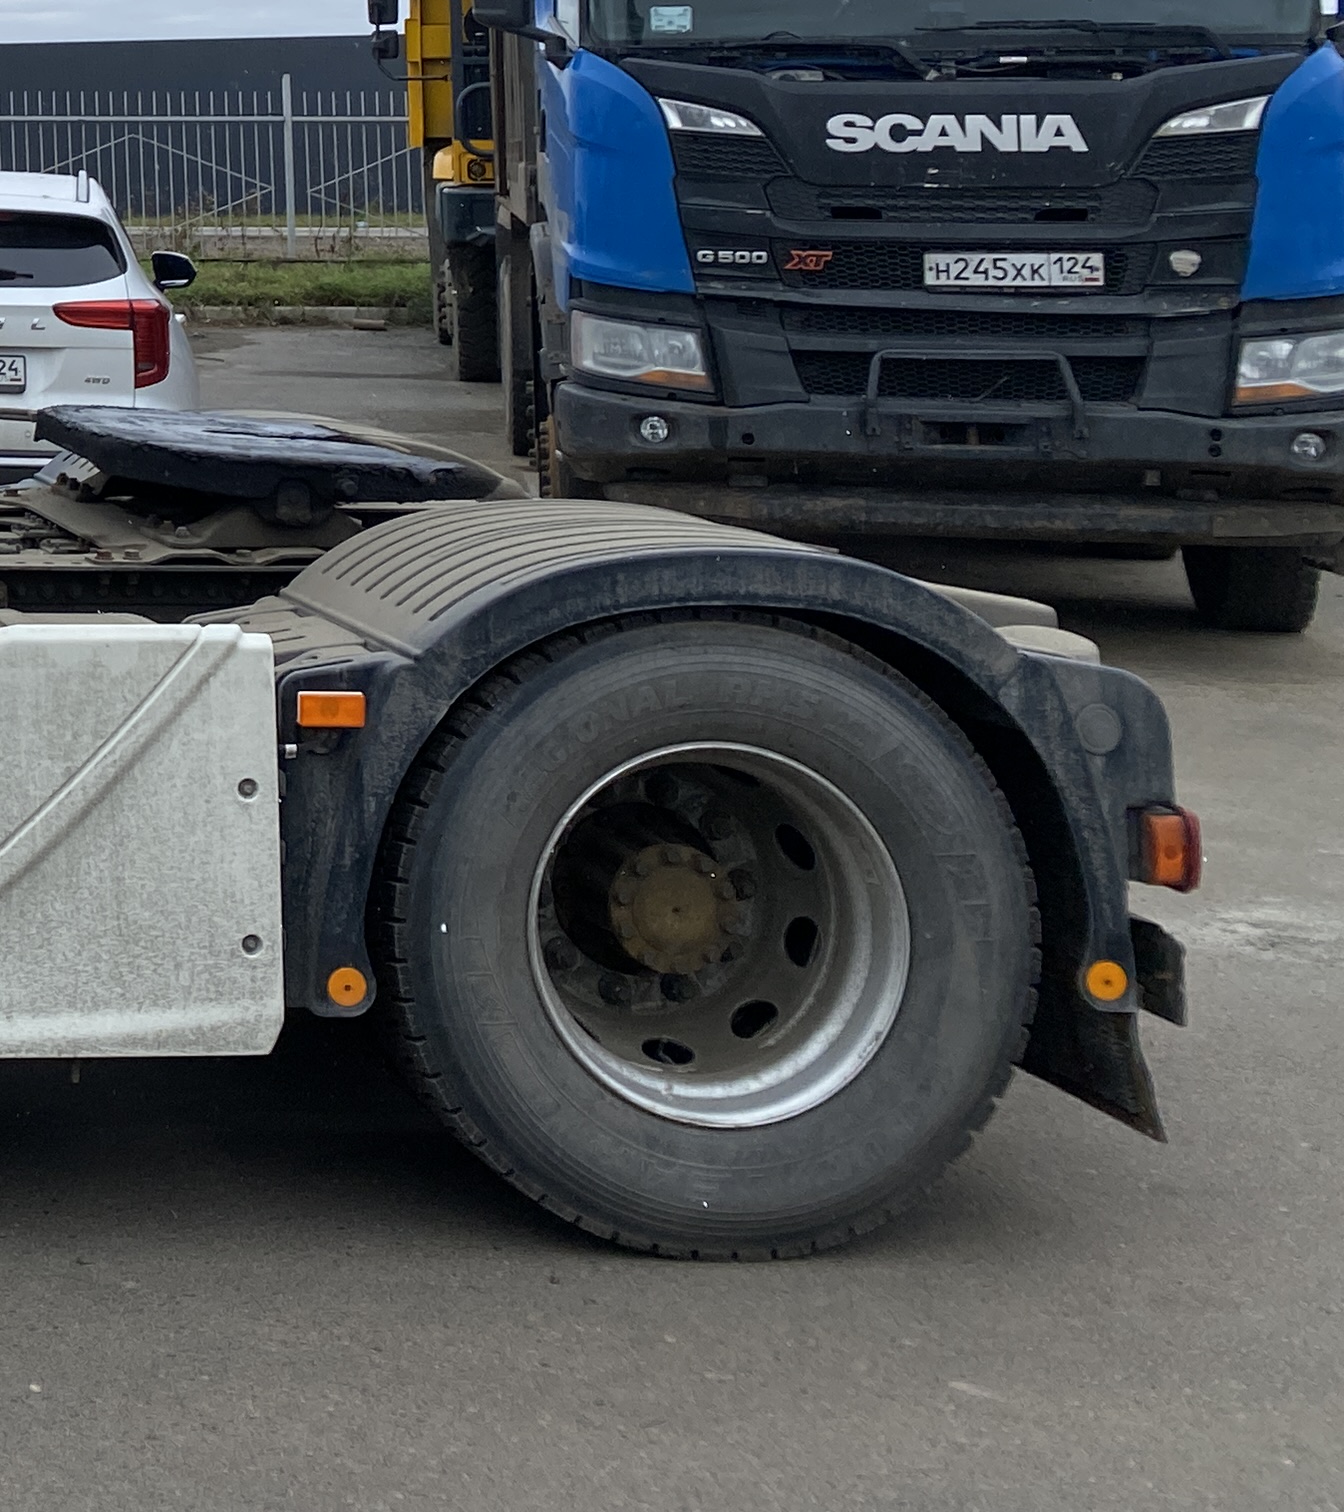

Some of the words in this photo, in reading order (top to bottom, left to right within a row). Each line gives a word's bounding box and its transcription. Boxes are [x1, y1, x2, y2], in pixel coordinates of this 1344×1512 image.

[826, 113, 1089, 153] SCANIA
[696, 249, 714, 263] G
[717, 250, 768, 264] 500
[783, 249, 833, 271] XT
[1053, 256, 1095, 275] 124
